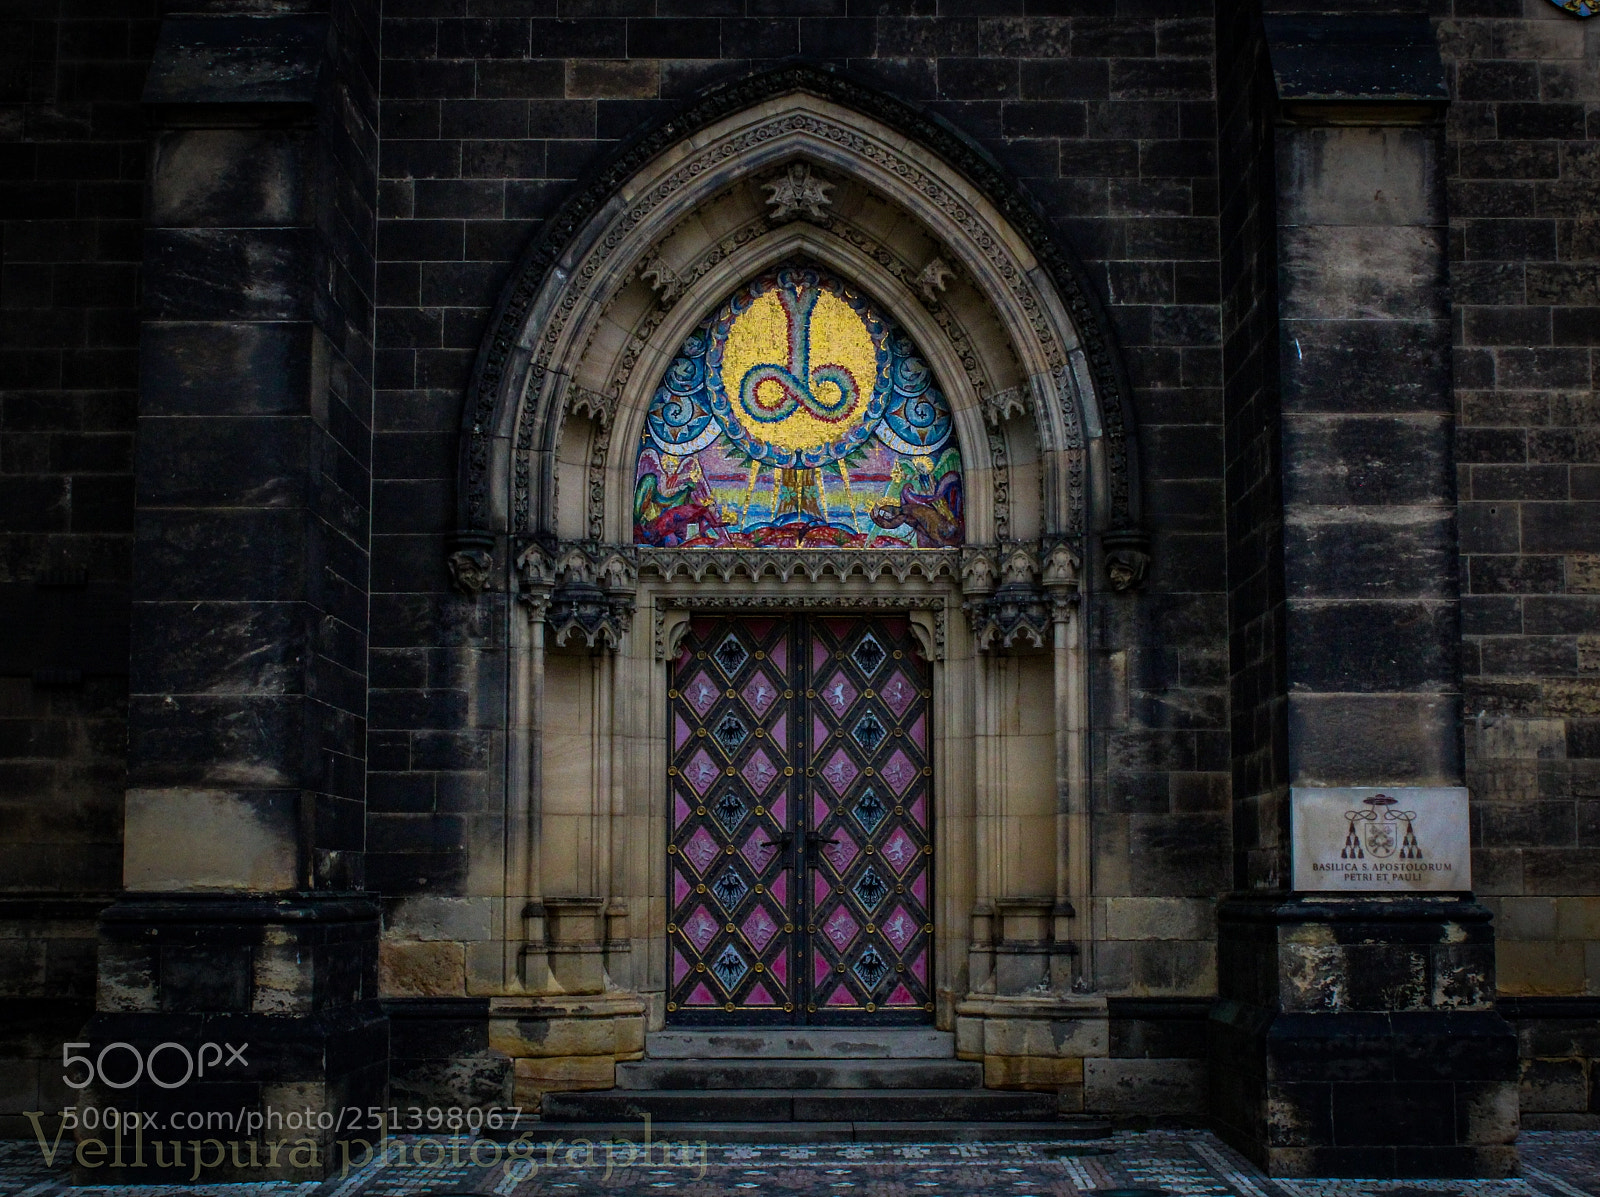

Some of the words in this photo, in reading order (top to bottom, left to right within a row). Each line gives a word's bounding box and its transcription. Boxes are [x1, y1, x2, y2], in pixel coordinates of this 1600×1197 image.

[1312, 862, 1358, 871] BASILICA
[1361, 862, 1370, 871] S.
[1372, 862, 1452, 871] APOSTOLORUM
[1344, 873, 1373, 881] PETRI
[1376, 873, 1388, 881] ET
[1392, 873, 1422, 881] PAULI
